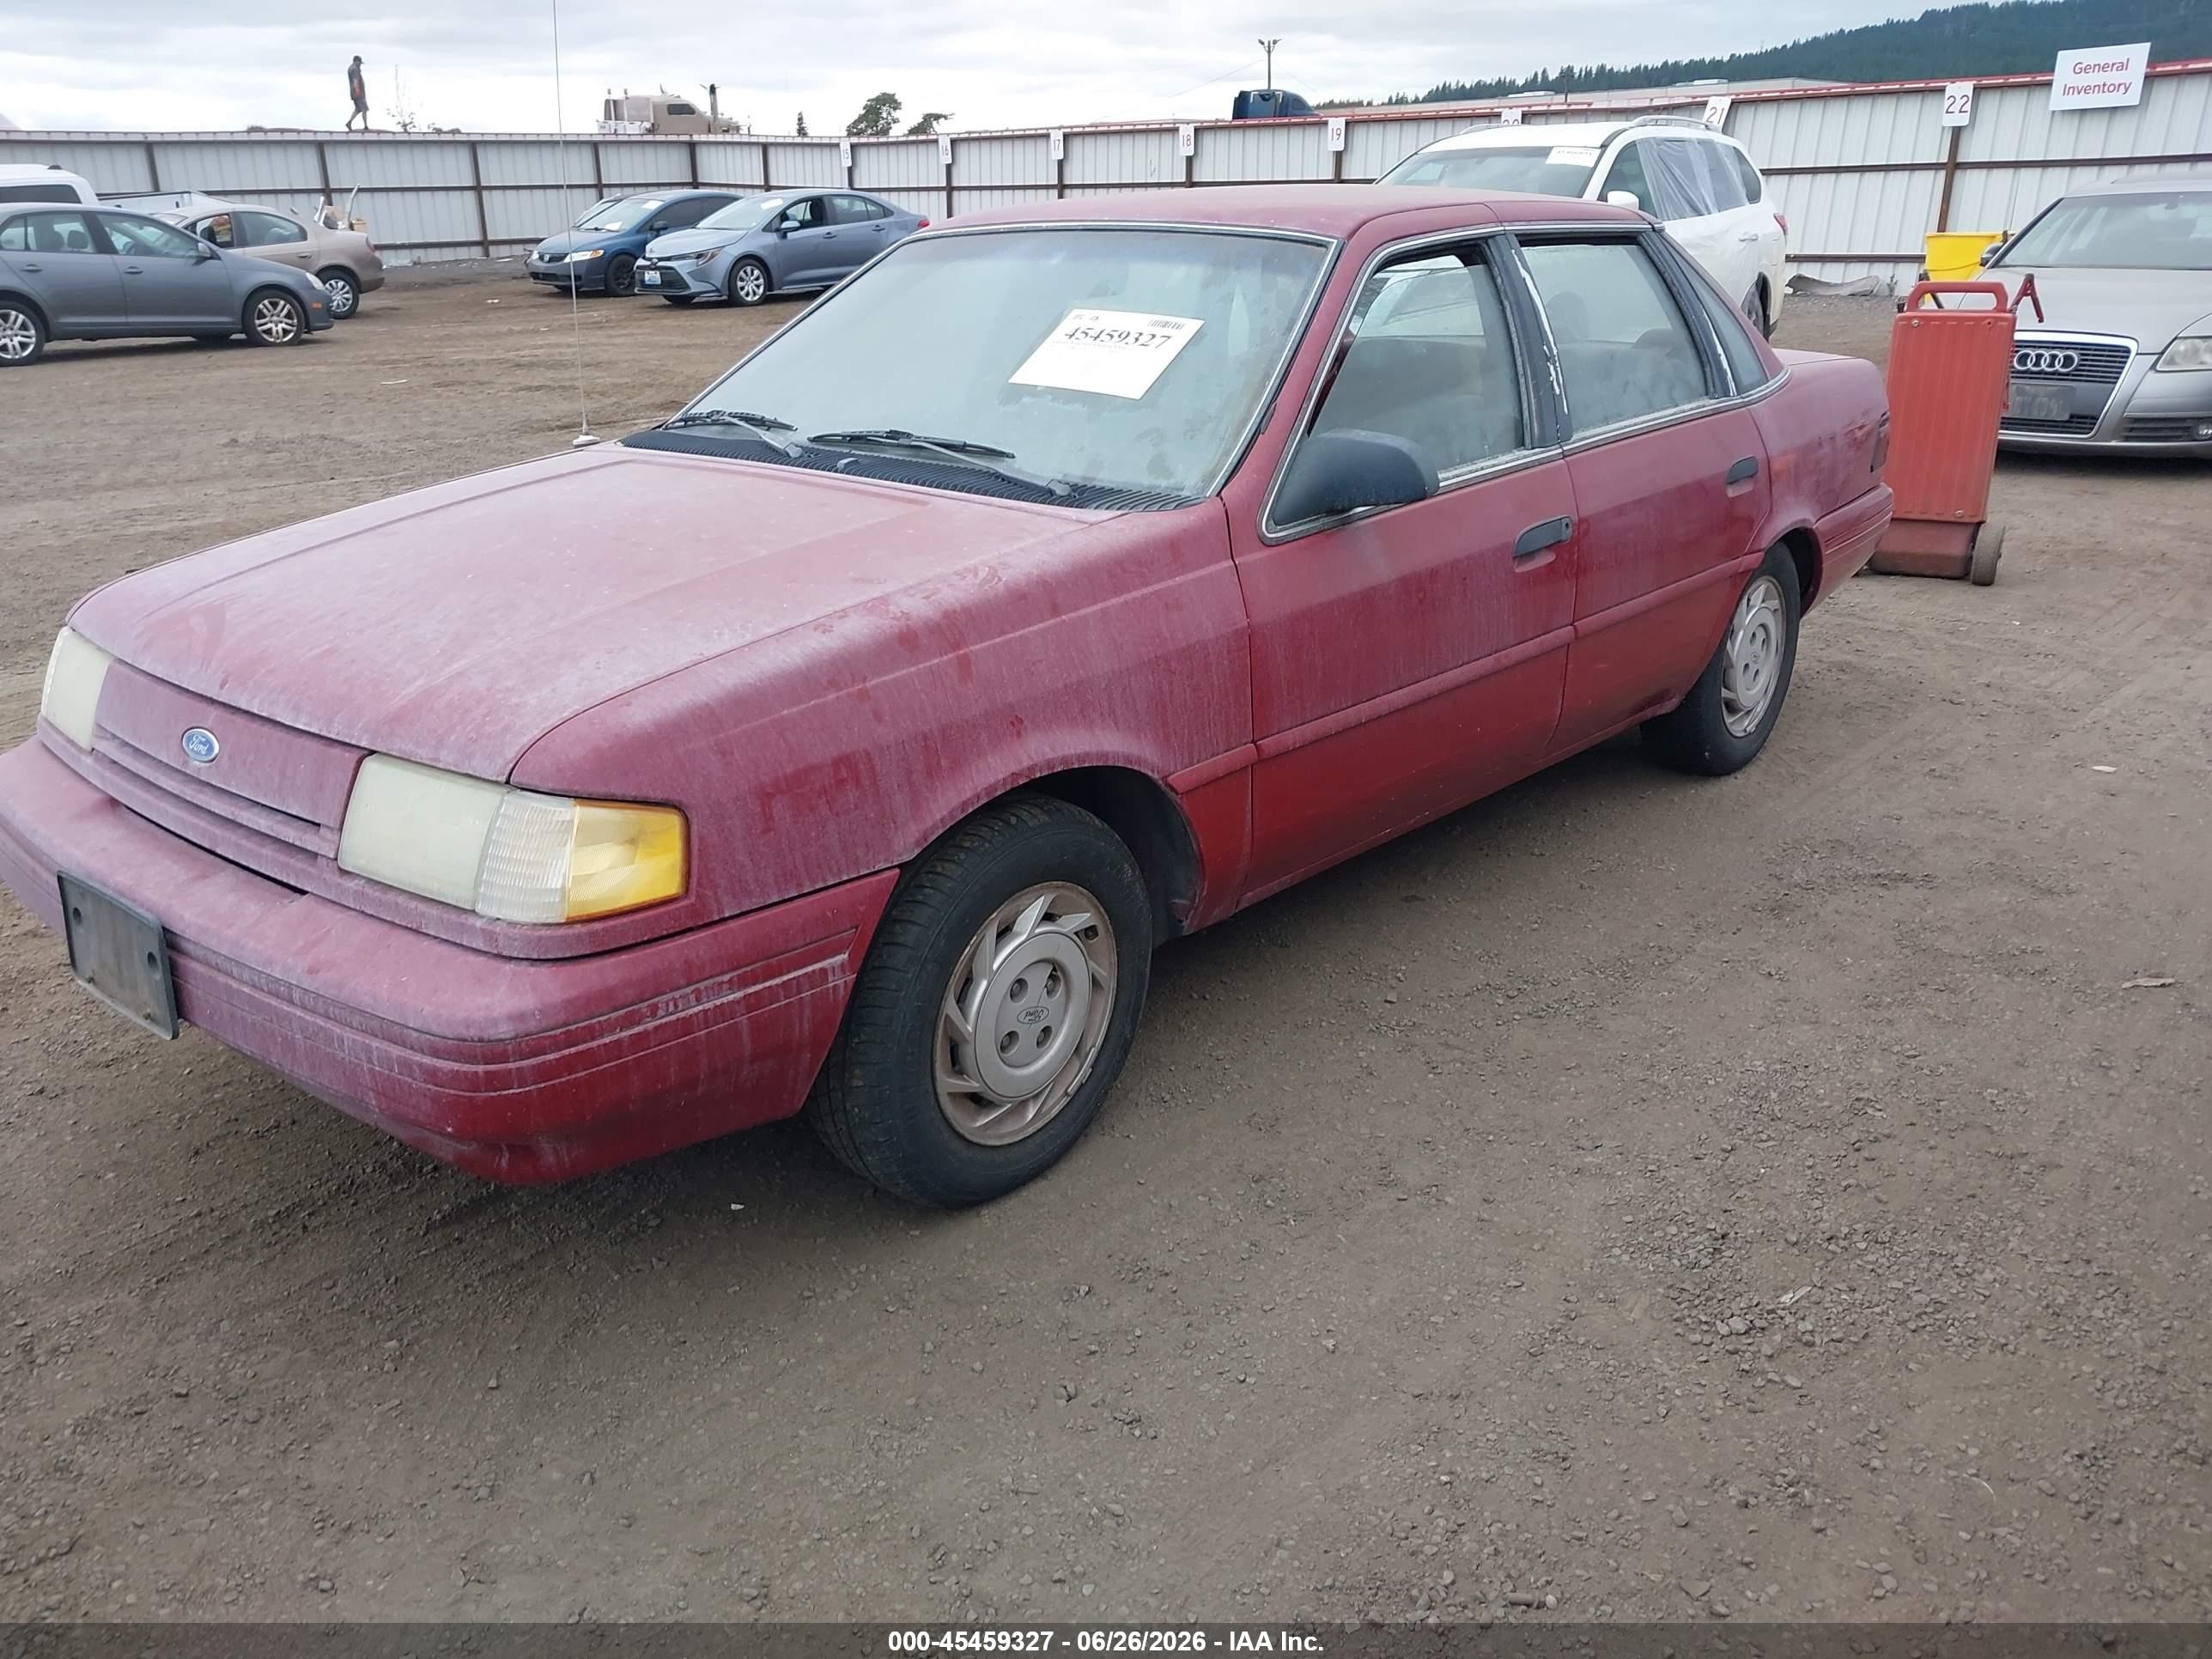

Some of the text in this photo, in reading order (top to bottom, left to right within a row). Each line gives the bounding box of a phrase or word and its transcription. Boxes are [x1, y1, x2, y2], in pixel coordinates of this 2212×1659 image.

[2073, 58, 2130, 75] General
[2062, 82, 2132, 96] Inventory
[1945, 94, 1970, 114] 22
[1705, 106, 1725, 125] 21
[1182, 134, 1192, 148] 18
[1331, 127, 1341, 141] 19
[941, 144, 950, 156] 16
[1053, 138, 1060, 152] 17
[842, 148, 850, 160] 15
[1064, 326, 1172, 349] 45459327
[189, 734, 210, 755] Ford
